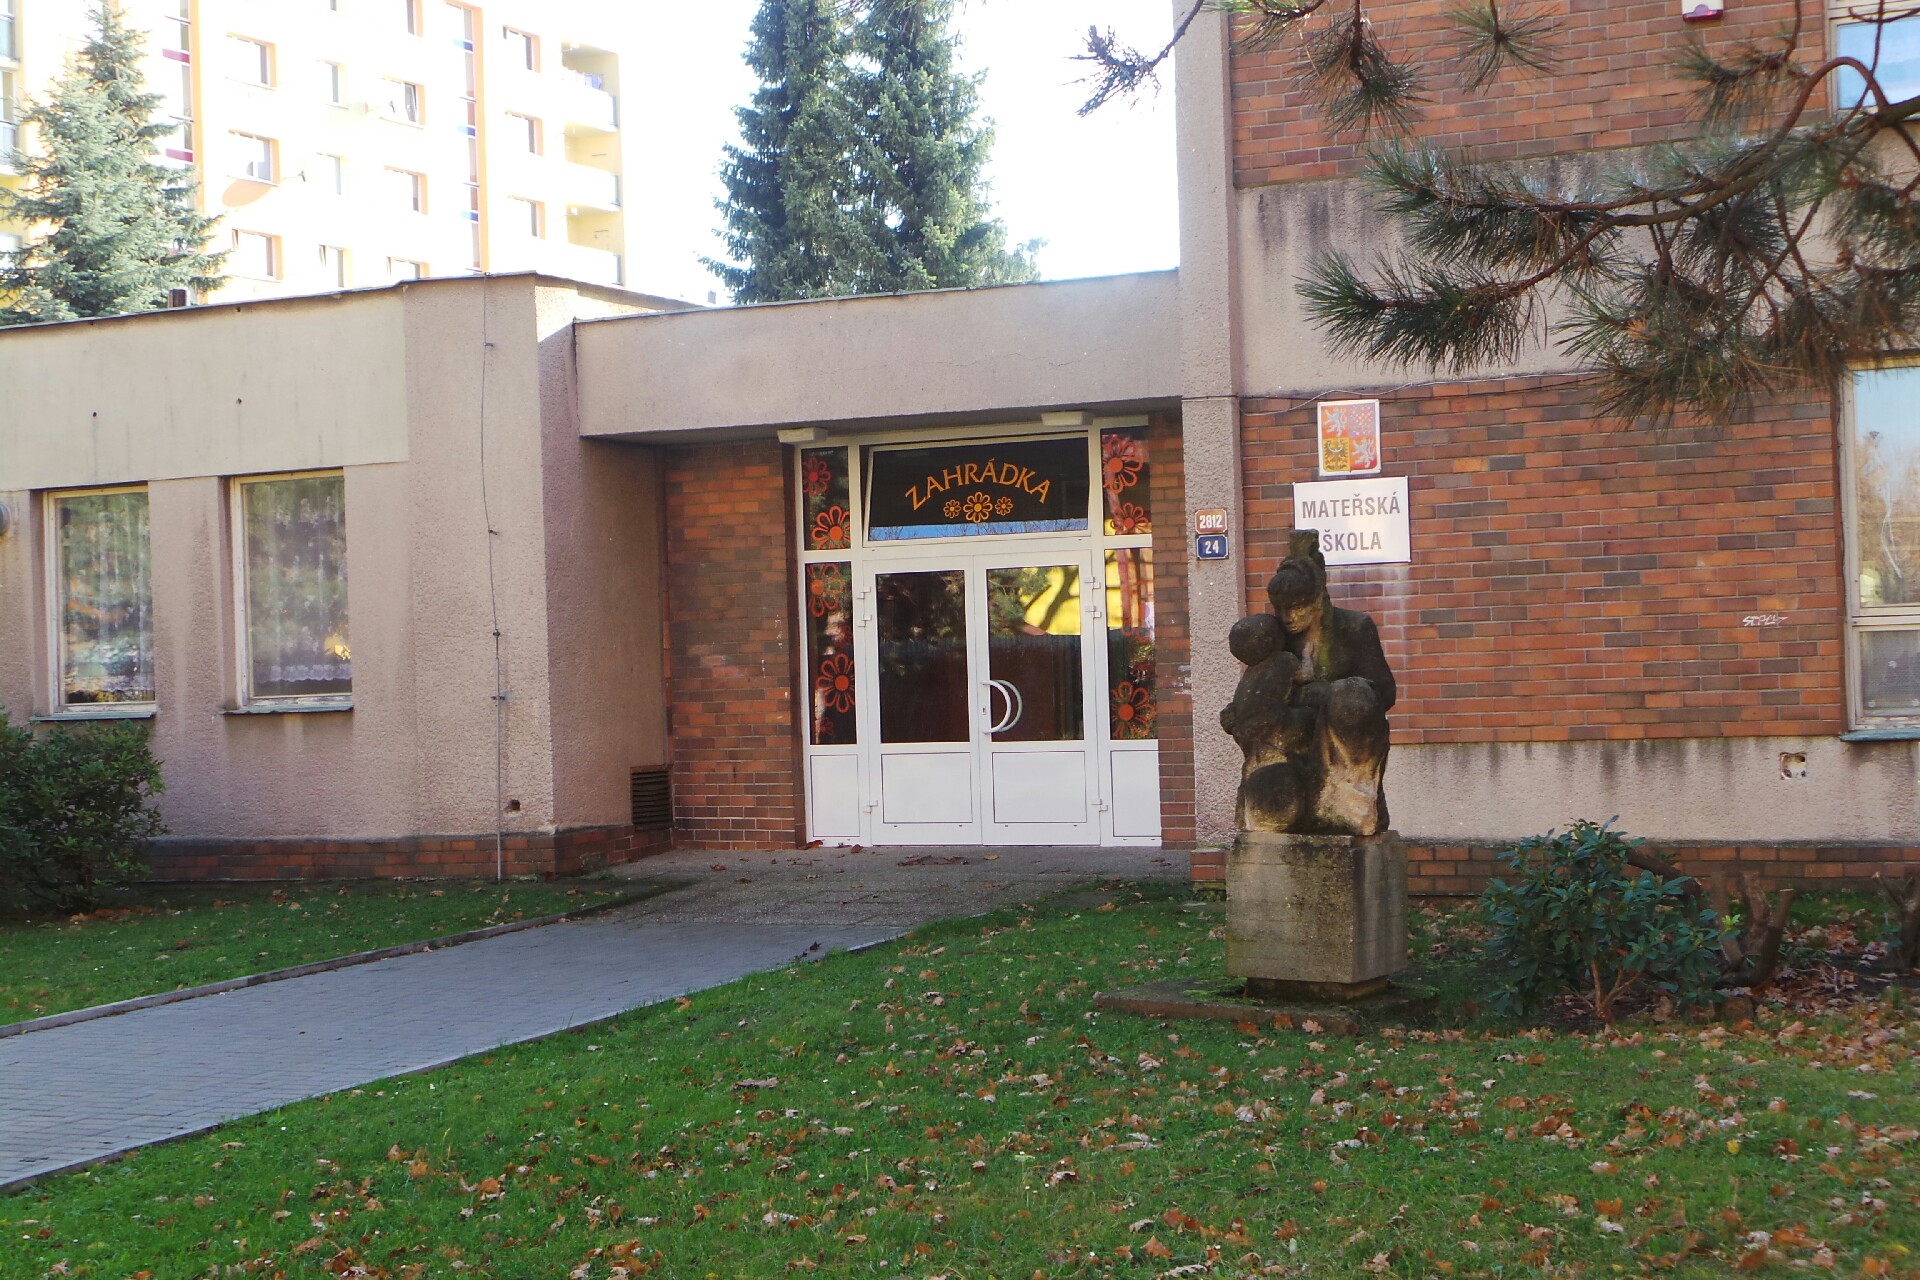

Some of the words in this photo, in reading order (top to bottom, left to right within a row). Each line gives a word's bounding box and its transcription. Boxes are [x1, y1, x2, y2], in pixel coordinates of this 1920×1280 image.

[905, 454, 1051, 511] ZAHRÁDKA
[1302, 491, 1401, 519] MATEŘSKÁ
[1199, 514, 1223, 529] 2812
[1204, 540, 1220, 555] 24
[1322, 529, 1382, 552] ŠKOLA
